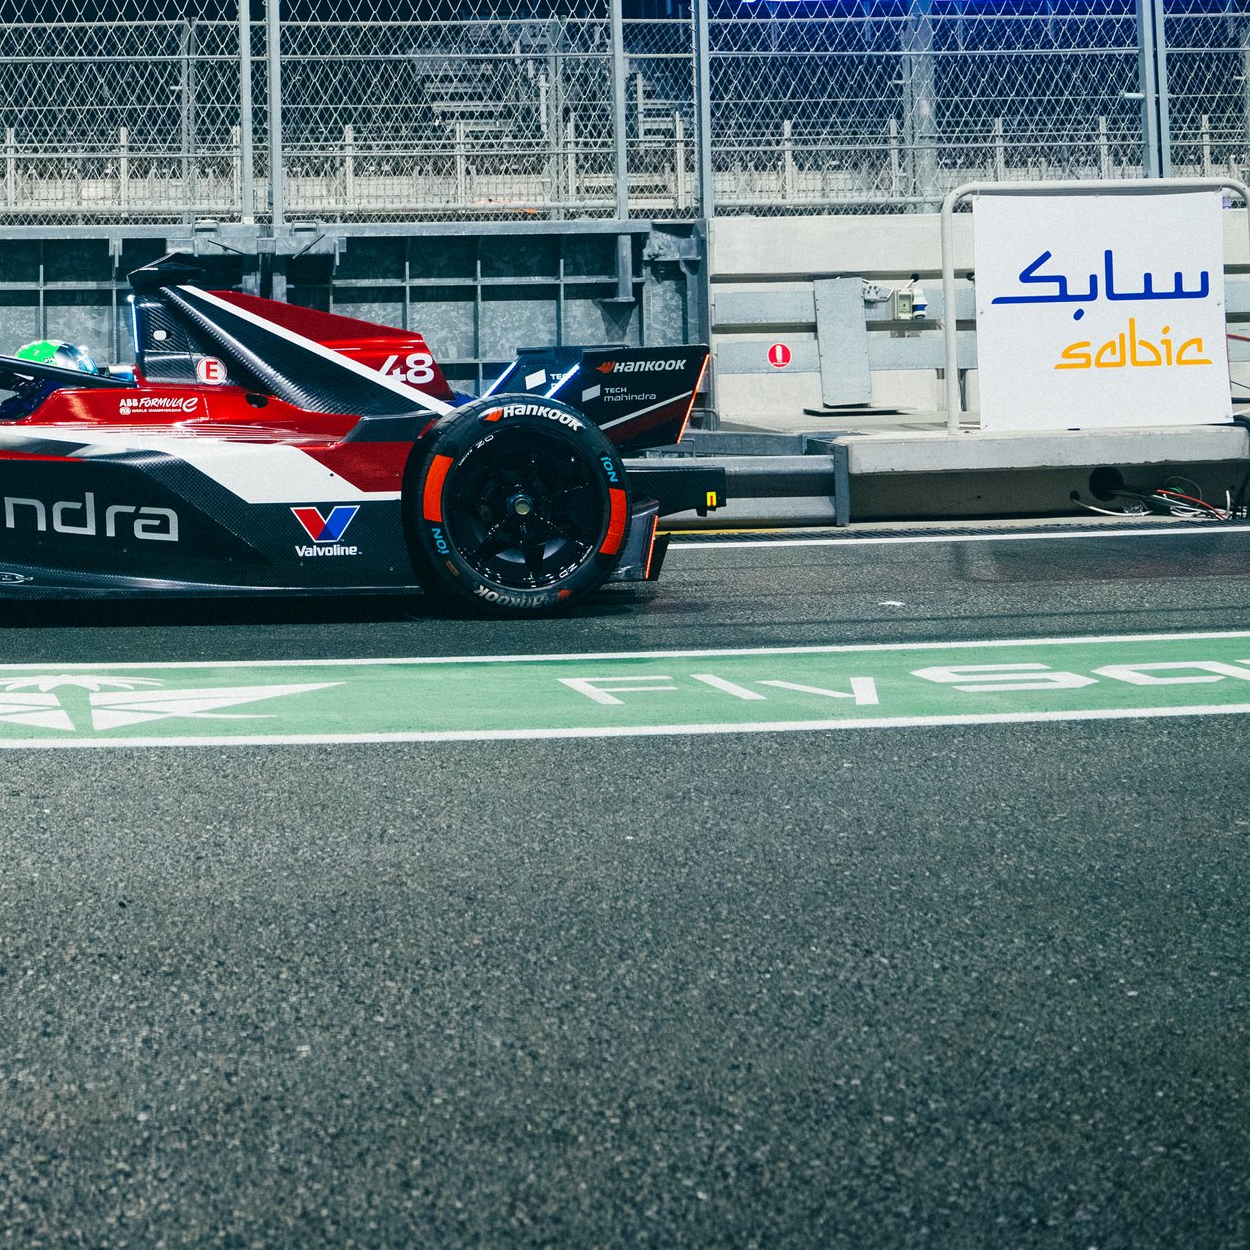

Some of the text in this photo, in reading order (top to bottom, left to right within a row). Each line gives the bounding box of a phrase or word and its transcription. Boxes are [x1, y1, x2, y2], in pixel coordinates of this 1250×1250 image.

[1053, 317, 1213, 370] sabic
[205, 361, 219, 380] E
[379, 352, 435, 384] 48
[119, 398, 138, 408] ABB
[138, 397, 183, 408] FORMULA
[603, 392, 657, 402] mahindra
[295, 544, 358, 557] Valvoline
